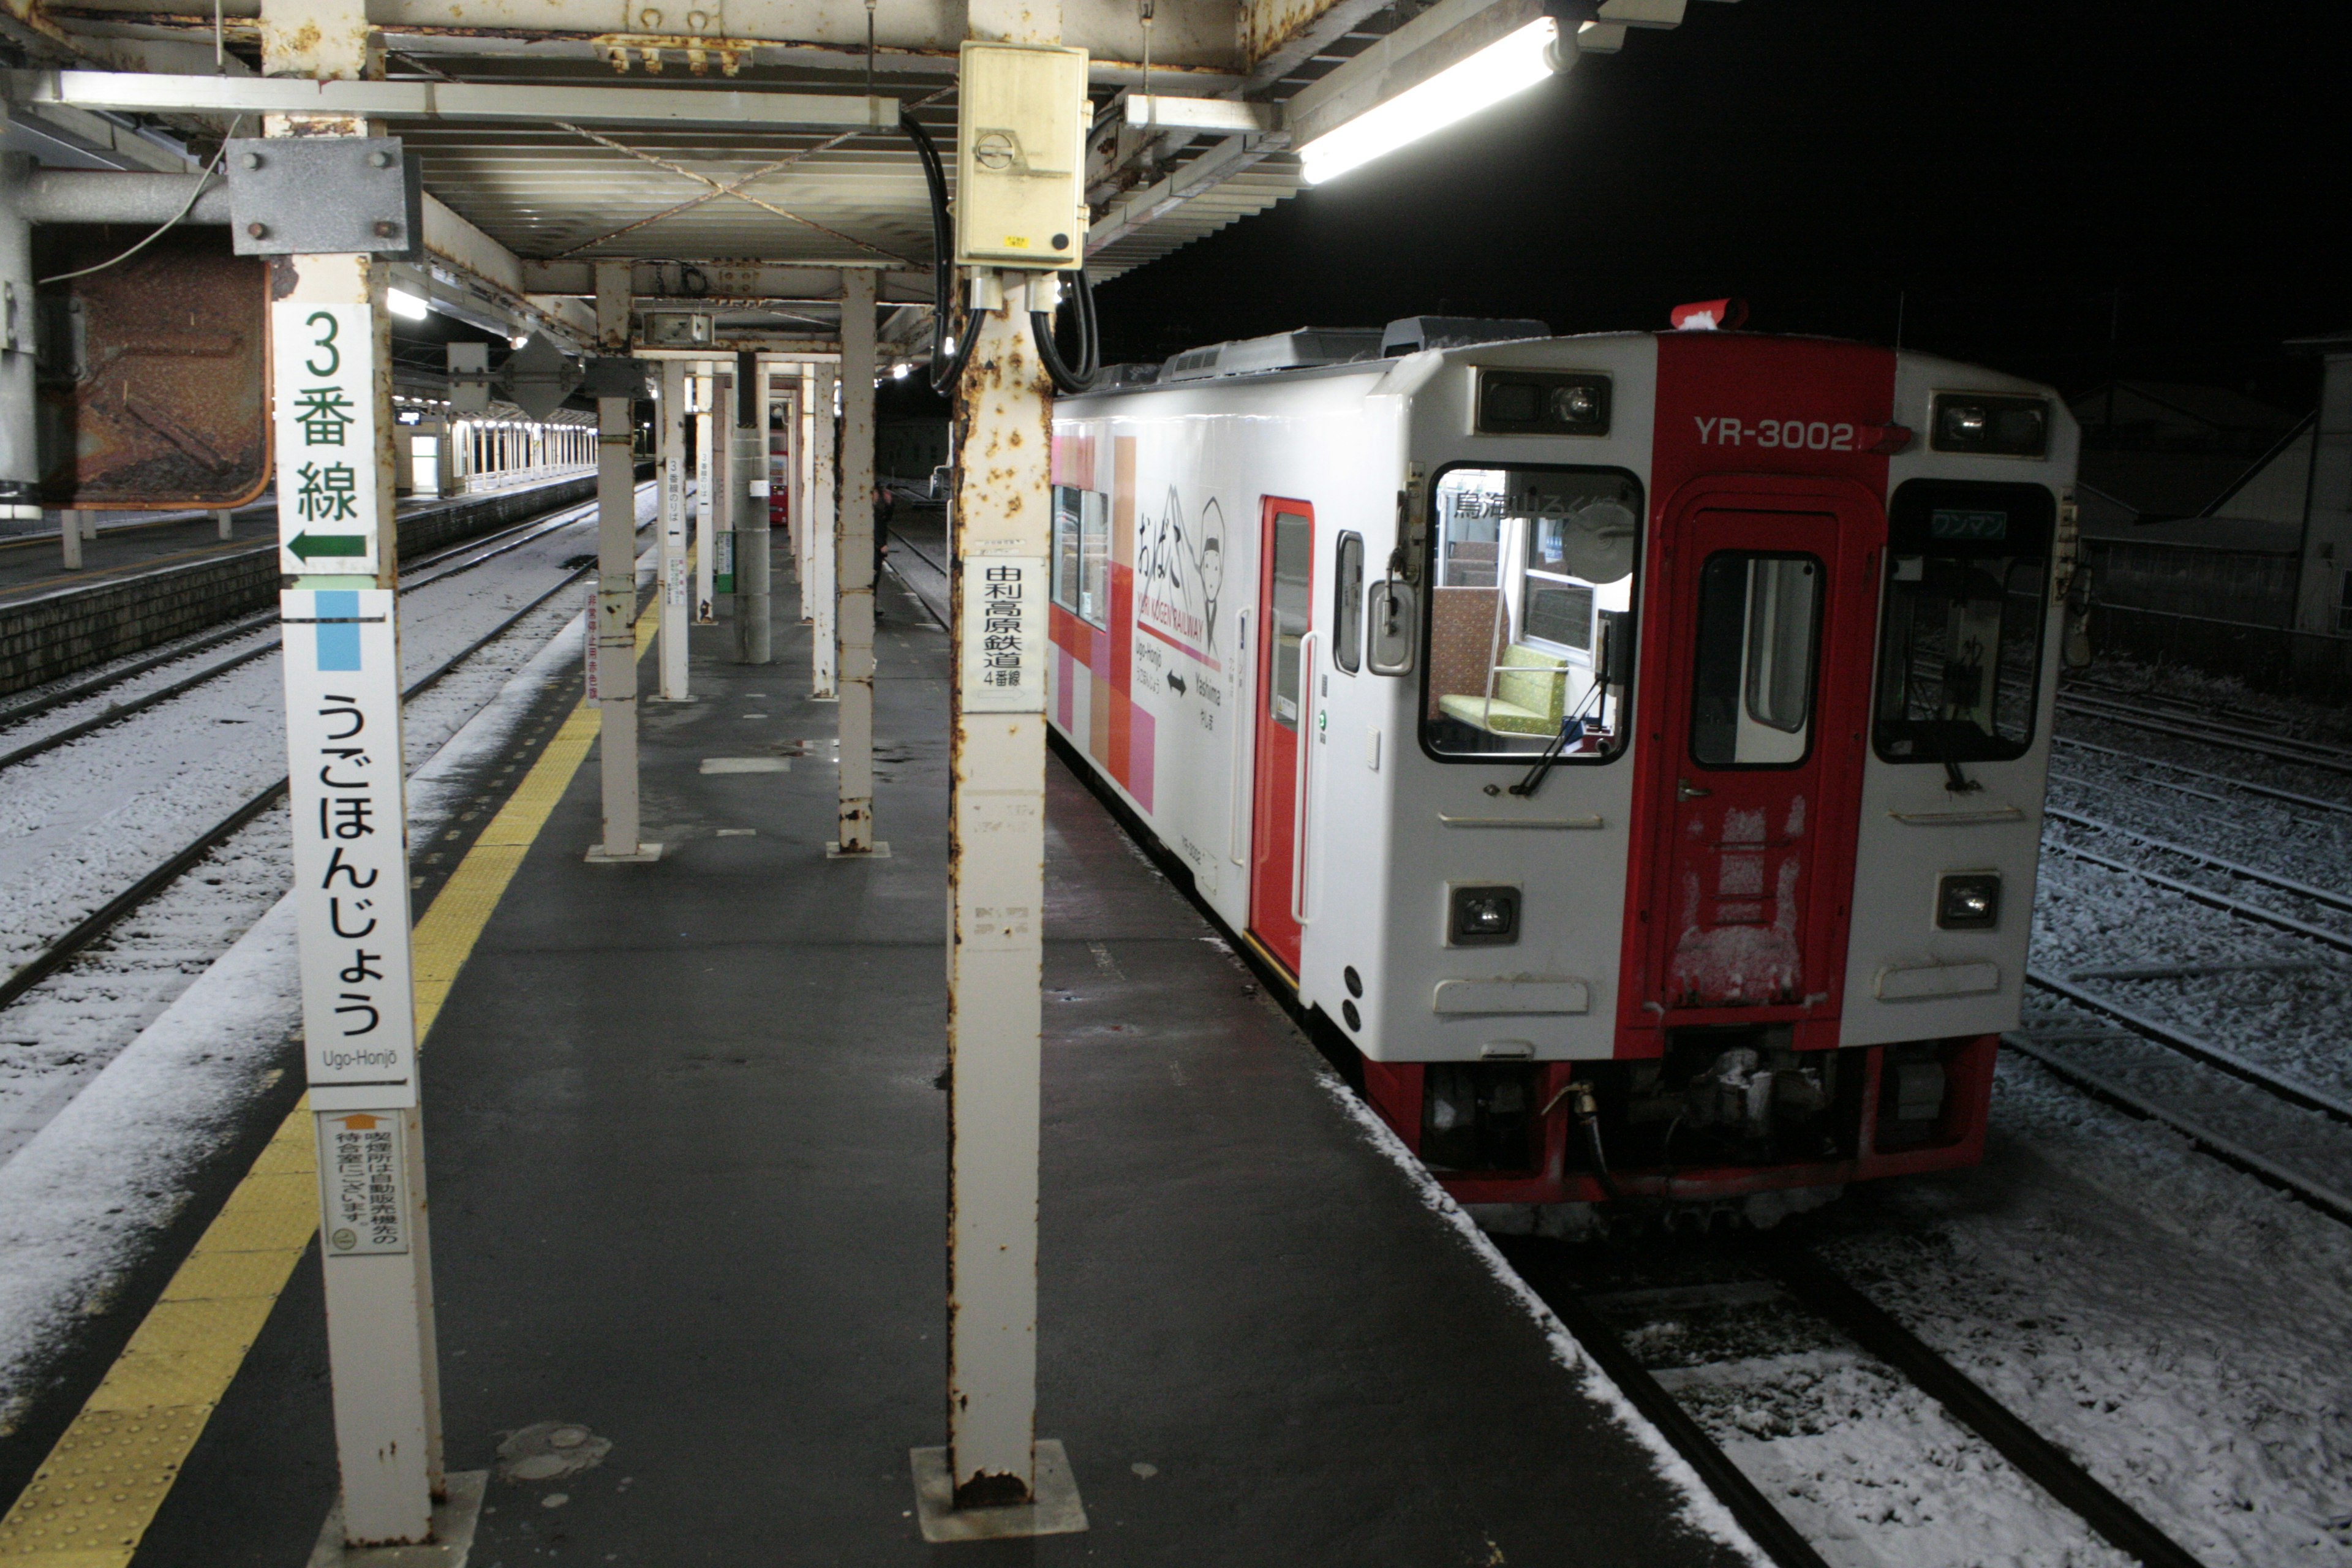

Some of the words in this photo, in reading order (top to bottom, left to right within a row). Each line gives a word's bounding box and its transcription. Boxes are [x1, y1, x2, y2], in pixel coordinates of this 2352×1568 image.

[294, 311, 358, 522] 3番線
[1694, 416, 1853, 451] YR-3002
[669, 461, 679, 521] 3番線のりば
[1454, 491, 1619, 519] 鳥海山ろく
[1931, 513, 2003, 537] ワンマン
[1138, 512, 1182, 589] おばこ
[984, 565, 1022, 668] 由利高原鉄道
[1173, 608, 1204, 643] RAILWAY
[984, 669, 1021, 687] 4番線
[1137, 666, 1161, 694] うごほんじょう
[1196, 672, 1220, 706] Yashima
[1200, 708, 1213, 730] やしま
[318, 694, 383, 1036] うごほんじょう
[323, 1050, 397, 1070] Ugo-Honjō
[364, 1132, 398, 1245] 喫煙所は自動販売機先の
